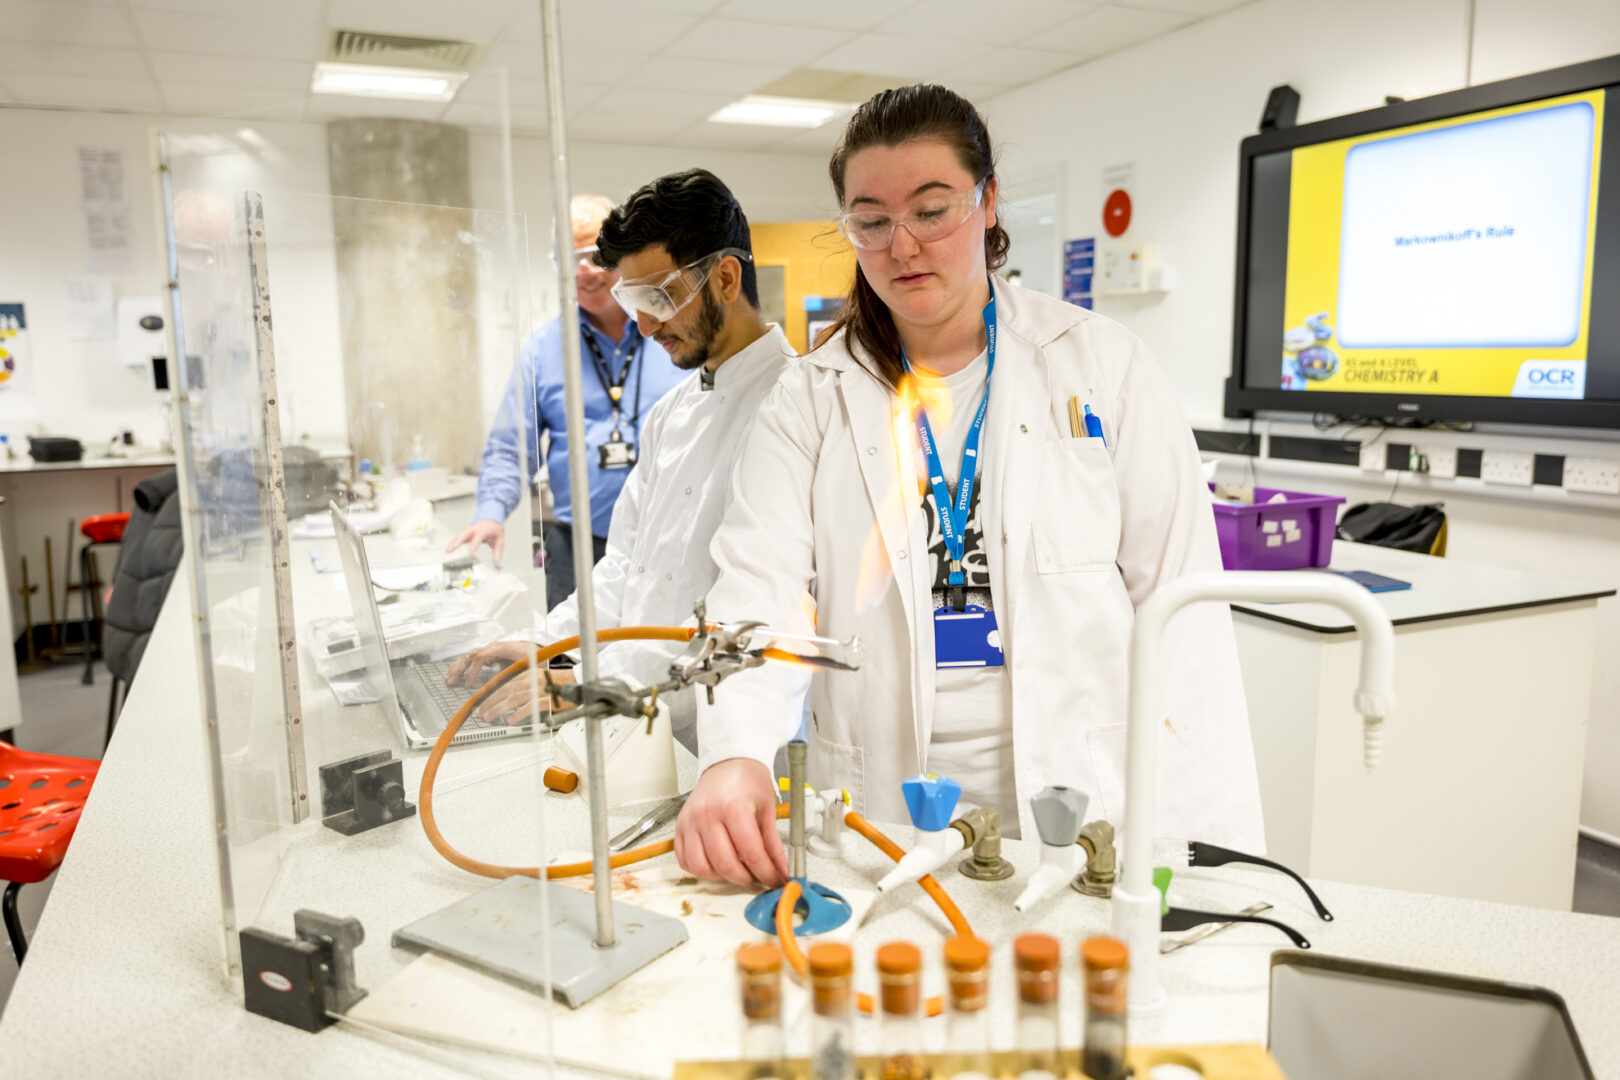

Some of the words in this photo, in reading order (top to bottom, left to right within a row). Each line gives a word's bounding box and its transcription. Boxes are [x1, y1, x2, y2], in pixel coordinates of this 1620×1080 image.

[1394, 229, 1481, 246] Markownikoff's
[1486, 225, 1515, 238] Rule
[1388, 358, 1418, 368] LEVEL
[1344, 367, 1426, 384] CHEMISTRY
[1428, 369, 1439, 384] A
[1528, 368, 1575, 385] OCR
[920, 426, 933, 455] STUDENT
[959, 477, 970, 511] STUDENT
[941, 506, 954, 539] STUDENT
